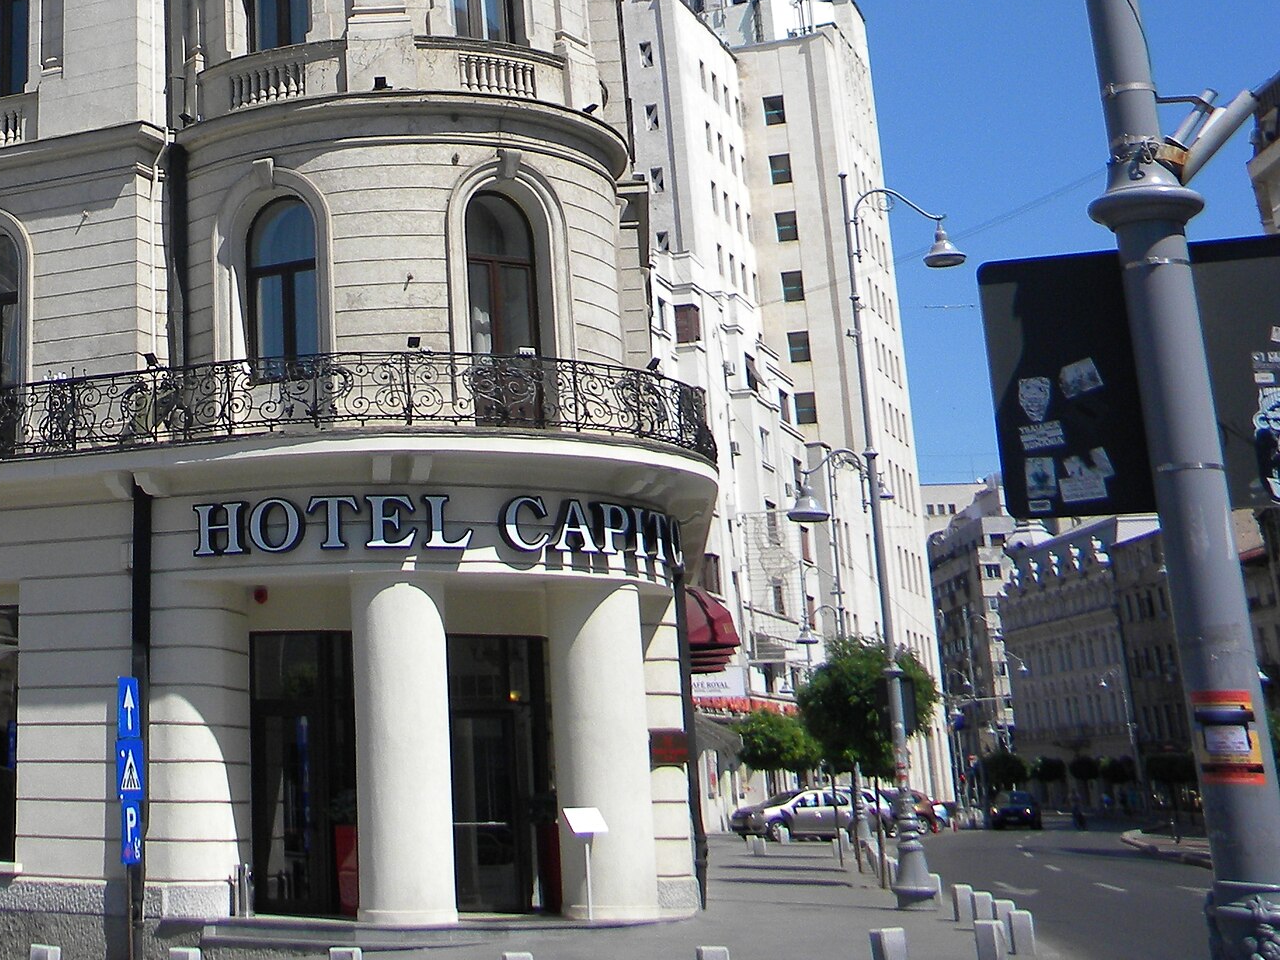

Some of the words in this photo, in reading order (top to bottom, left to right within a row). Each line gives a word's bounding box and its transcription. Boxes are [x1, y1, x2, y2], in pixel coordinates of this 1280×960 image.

[193, 495, 473, 557] HOTEL
[706, 681, 730, 690] ROYAL
[126, 806, 137, 844] P
